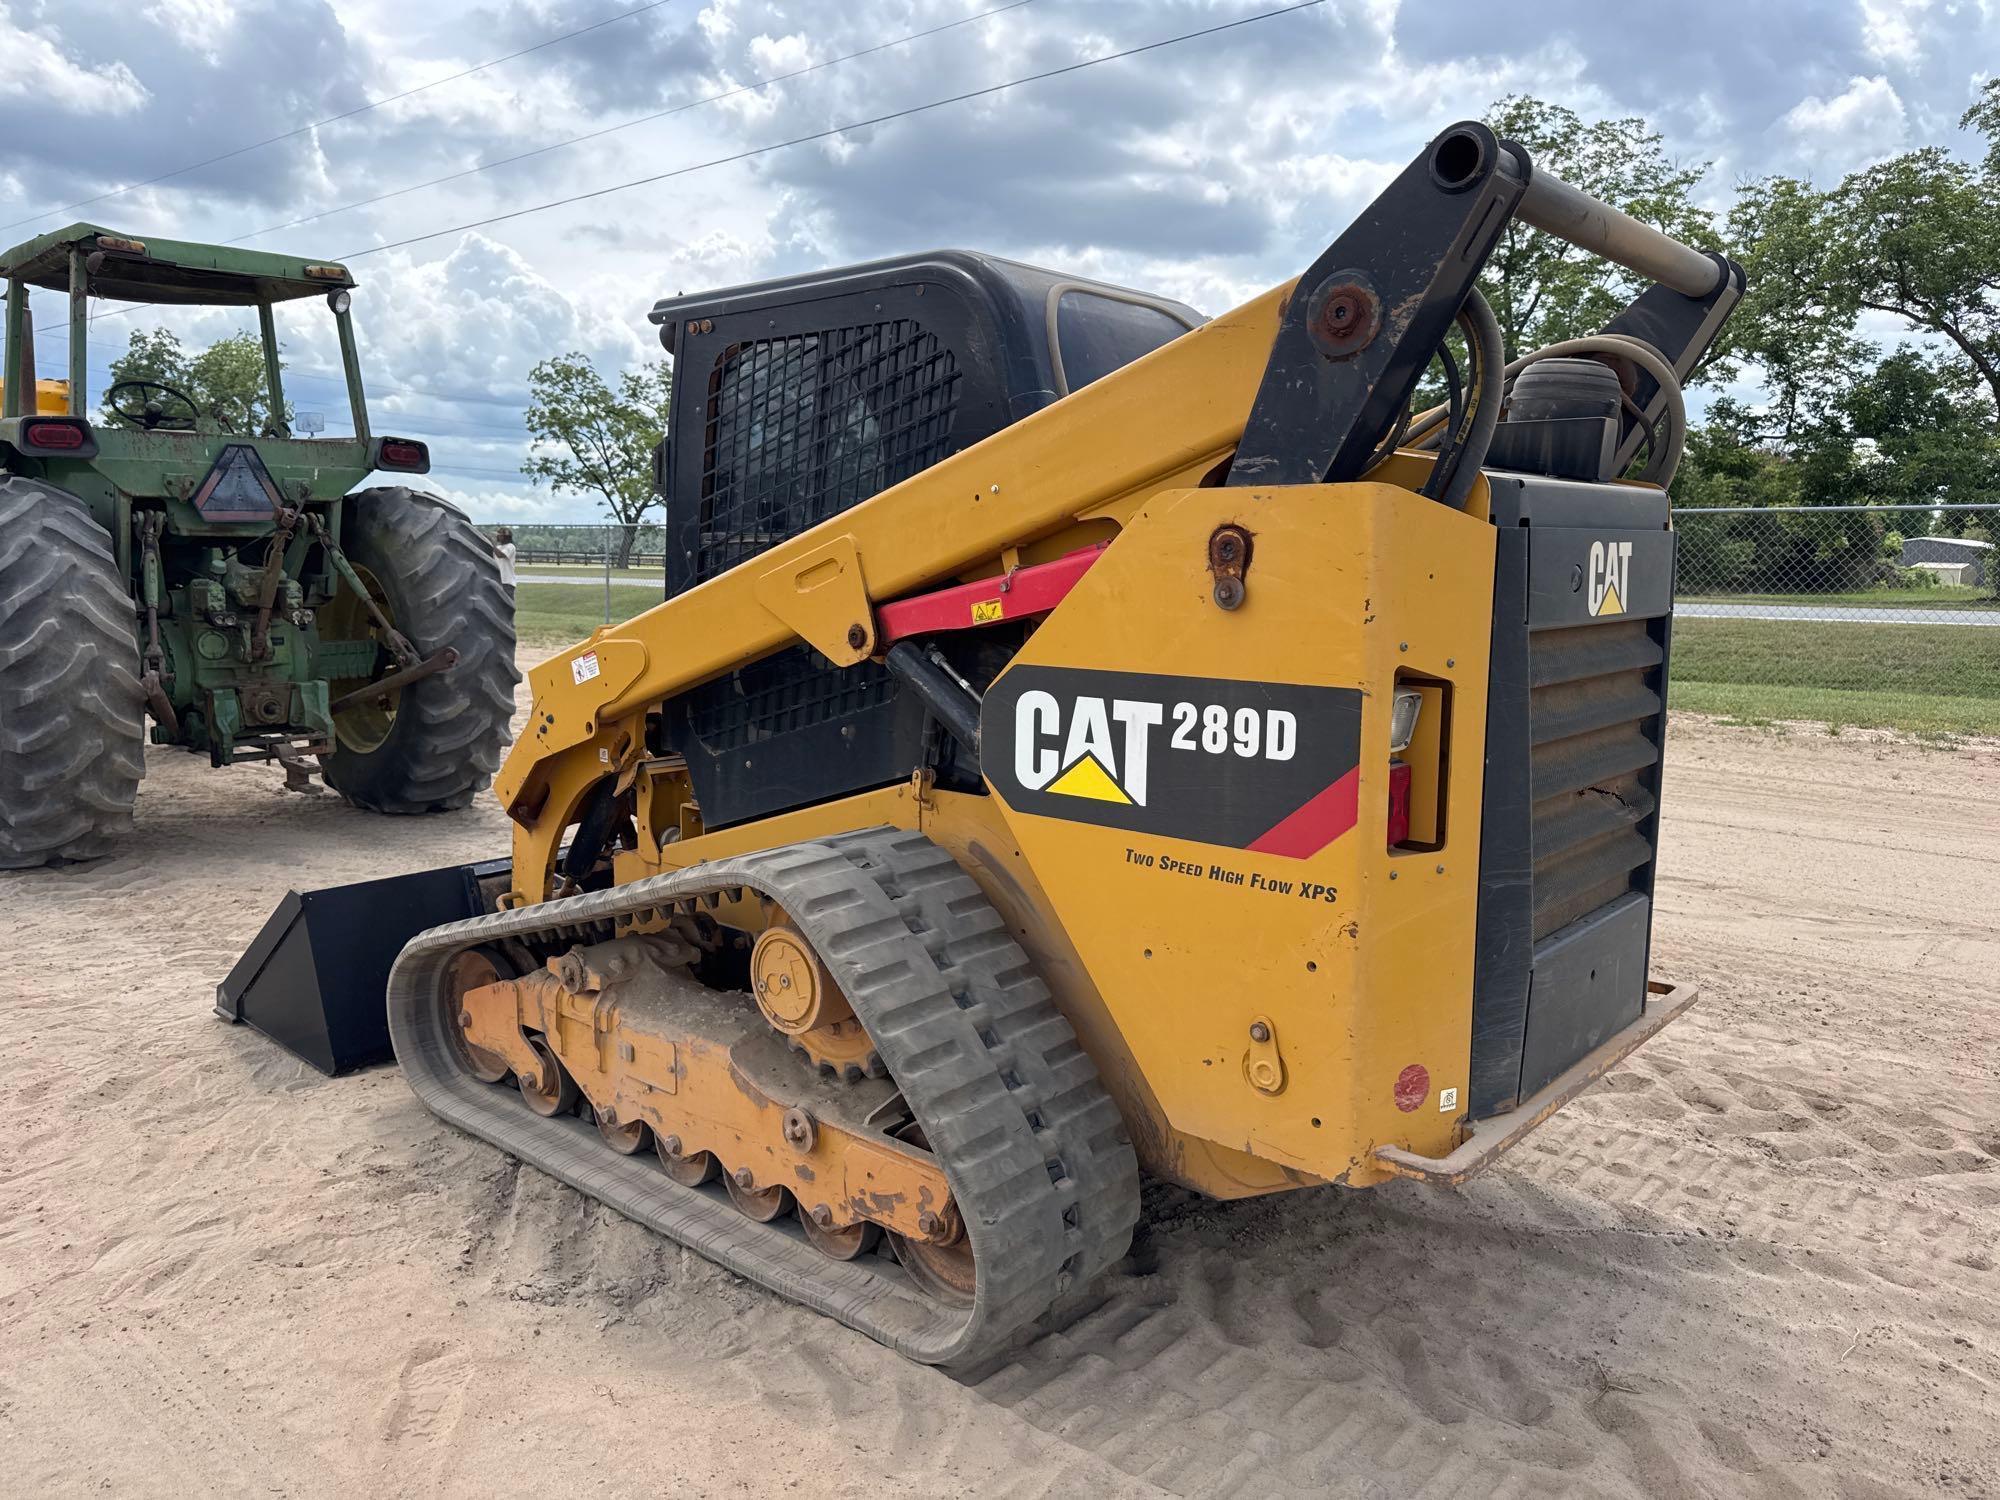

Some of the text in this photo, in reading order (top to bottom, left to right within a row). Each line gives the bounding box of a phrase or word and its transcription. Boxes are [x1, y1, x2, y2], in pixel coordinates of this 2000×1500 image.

[1587, 540, 1633, 617] CAT
[1014, 689, 1298, 807] CAT 289D
[1298, 881, 1338, 904] XPS
